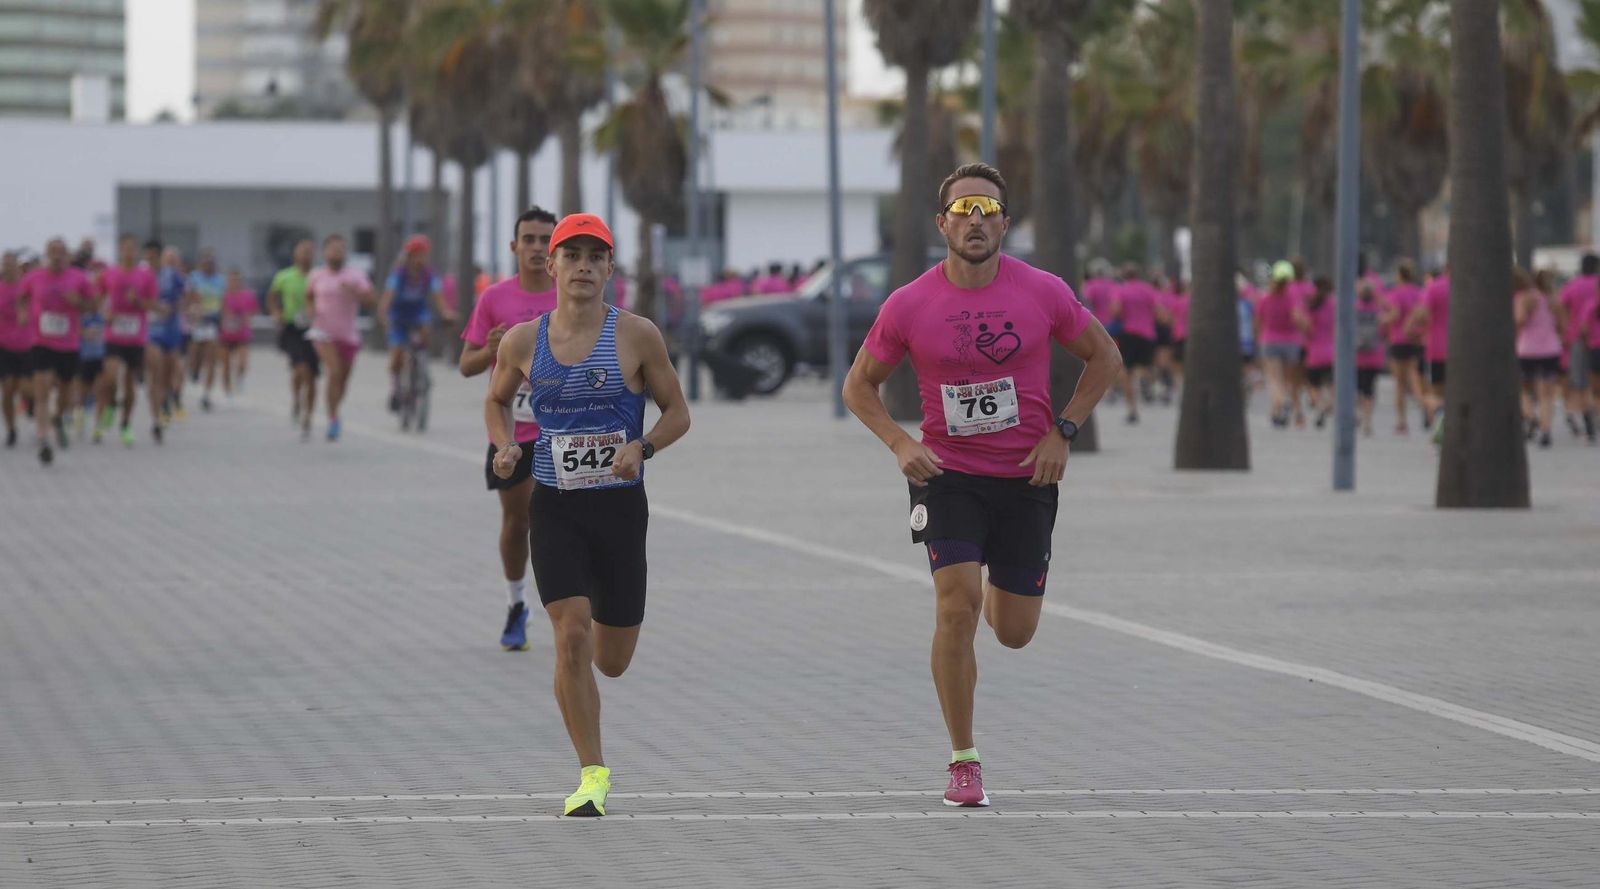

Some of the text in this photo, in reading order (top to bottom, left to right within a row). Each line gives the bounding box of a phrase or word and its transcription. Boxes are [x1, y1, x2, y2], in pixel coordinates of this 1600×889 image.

[957, 383, 1012, 399] POR LA MUJER
[974, 379, 1009, 391] CARRERA
[539, 404, 553, 414] Club
[553, 405, 587, 416] Atletismo
[959, 395, 998, 419] 76
[568, 437, 624, 449] POR LA MUJER
[586, 432, 622, 443] CARRERA
[562, 446, 617, 473] 542
